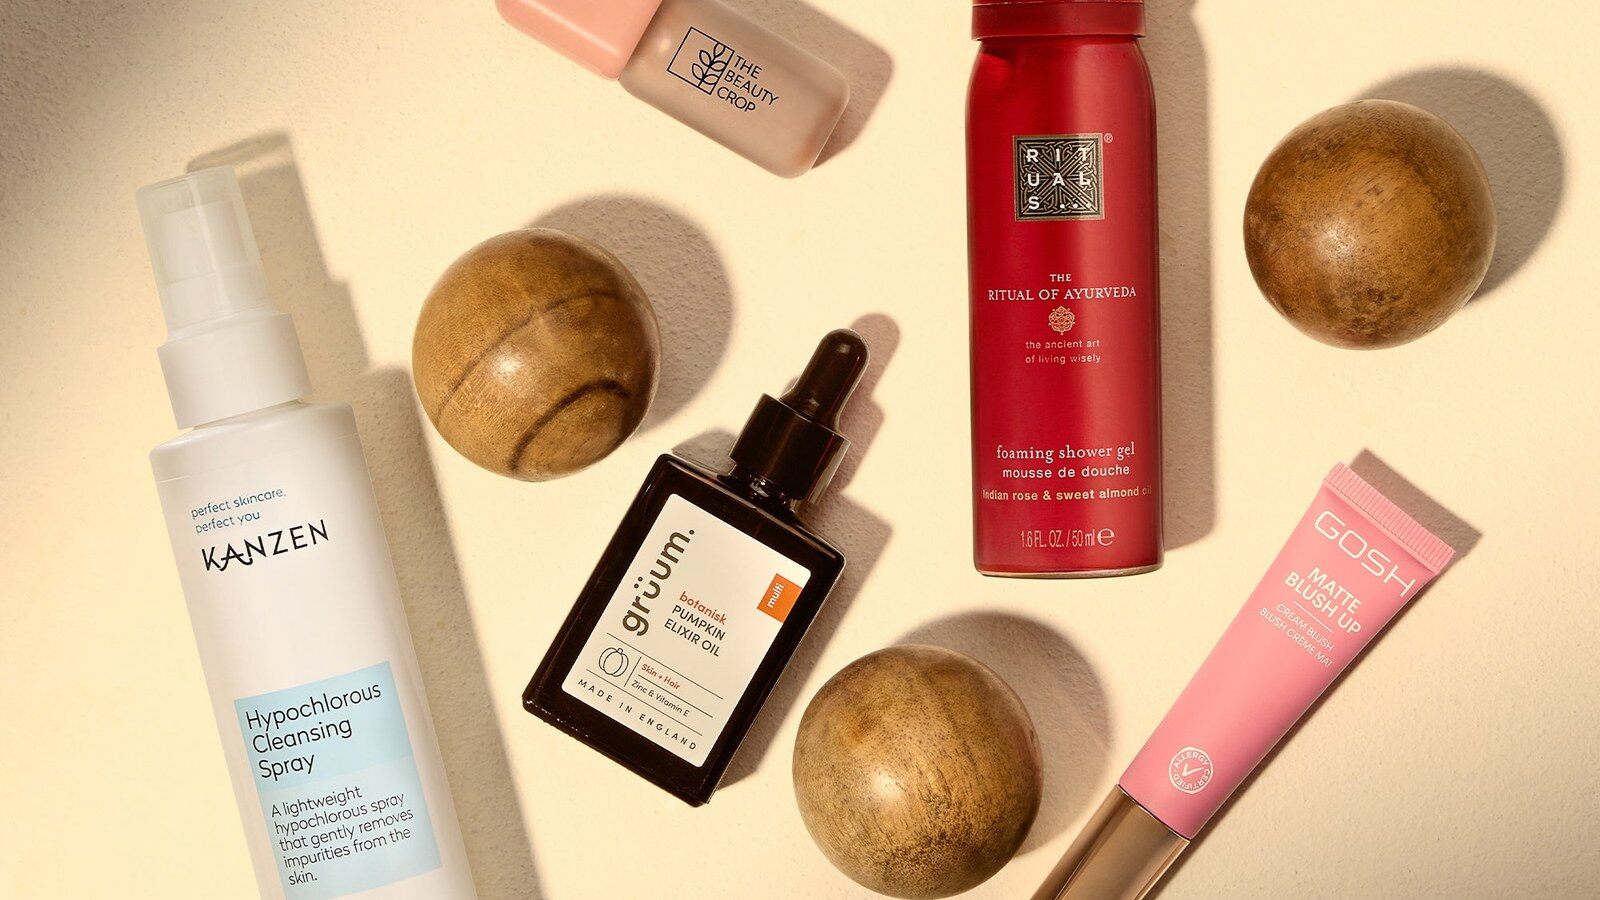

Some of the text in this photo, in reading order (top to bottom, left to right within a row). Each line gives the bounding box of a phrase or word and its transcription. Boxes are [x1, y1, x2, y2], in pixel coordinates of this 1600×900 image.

[735, 55, 762, 79] THE
[717, 87, 756, 112] CROP
[724, 70, 779, 105] BEAUTY
[988, 286, 1136, 301] RITUAL OF AYURVEDA
[1050, 273, 1072, 282] THE
[1025, 354, 1101, 365] of living wisely
[1026, 339, 1100, 349] the ancient art
[997, 441, 1135, 463] foaming shower gel
[1002, 465, 1130, 478] mousse de douche
[191, 488, 286, 520] perfect skincare.
[982, 489, 1009, 500] Indian
[1012, 492, 1038, 500] rose
[1043, 490, 1052, 500] &
[1056, 489, 1094, 500] sweet
[1099, 486, 1139, 499] almond
[195, 510, 260, 534] perfect you
[201, 519, 329, 572] KANZEN
[1021, 530, 1033, 547] 1.6
[1034, 530, 1047, 547] FL.
[1049, 530, 1065, 547] OZ.
[1314, 510, 1417, 597] GOSH
[621, 529, 695, 637] grüum.
[765, 582, 785, 608] multi
[1307, 566, 1362, 614] MATTE
[679, 590, 728, 625] botanisk
[1284, 571, 1362, 634] BLUSH UP
[664, 618, 719, 657] ELIXIR OIL
[672, 604, 726, 641] PUMPKIN
[1260, 607, 1288, 631] BLUSH
[1314, 651, 1334, 668] MAT
[1276, 603, 1334, 652] CREAM BLUSH
[641, 663, 658, 678] Skin
[663, 676, 680, 690] Hair
[245, 683, 382, 732] Hypochlorous
[631, 679, 690, 717] Zinc & Vitamin E
[578, 679, 697, 750] MADE IN ENGLAND
[252, 718, 353, 753] Cleansing
[258, 754, 315, 781] Spray
[1174, 751, 1210, 768] ALLERGY
[1173, 768, 1210, 790] CERTIFIED
[271, 786, 363, 818] A lightweight
[274, 793, 404, 836] hypochlorous spray
[279, 808, 414, 852] that gently removes
[283, 826, 411, 869] impurities from the
[288, 869, 318, 886] skin.
